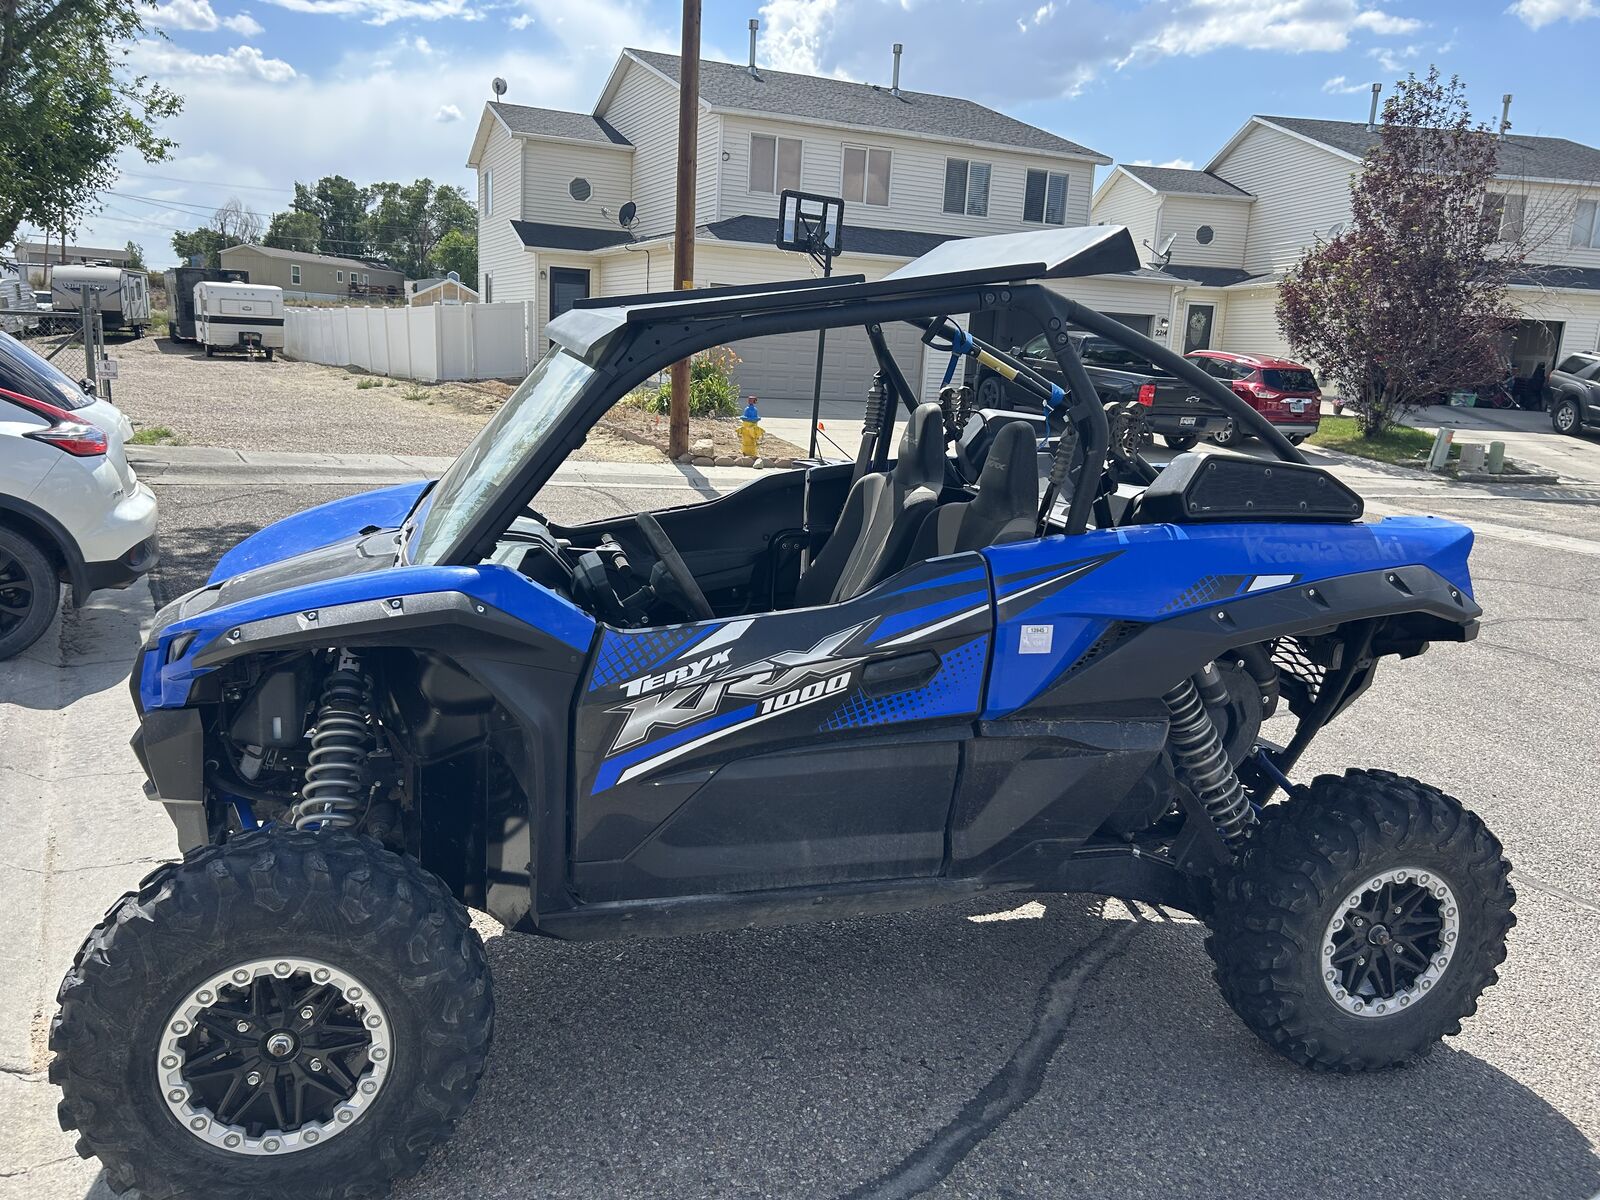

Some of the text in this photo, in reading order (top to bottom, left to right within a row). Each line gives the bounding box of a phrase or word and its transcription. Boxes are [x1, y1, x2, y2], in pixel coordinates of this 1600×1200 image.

[1243, 534, 1407, 563] Kawasaki
[603, 616, 878, 758] KRX
[619, 647, 733, 697] TERYX
[761, 671, 852, 715] 1000
